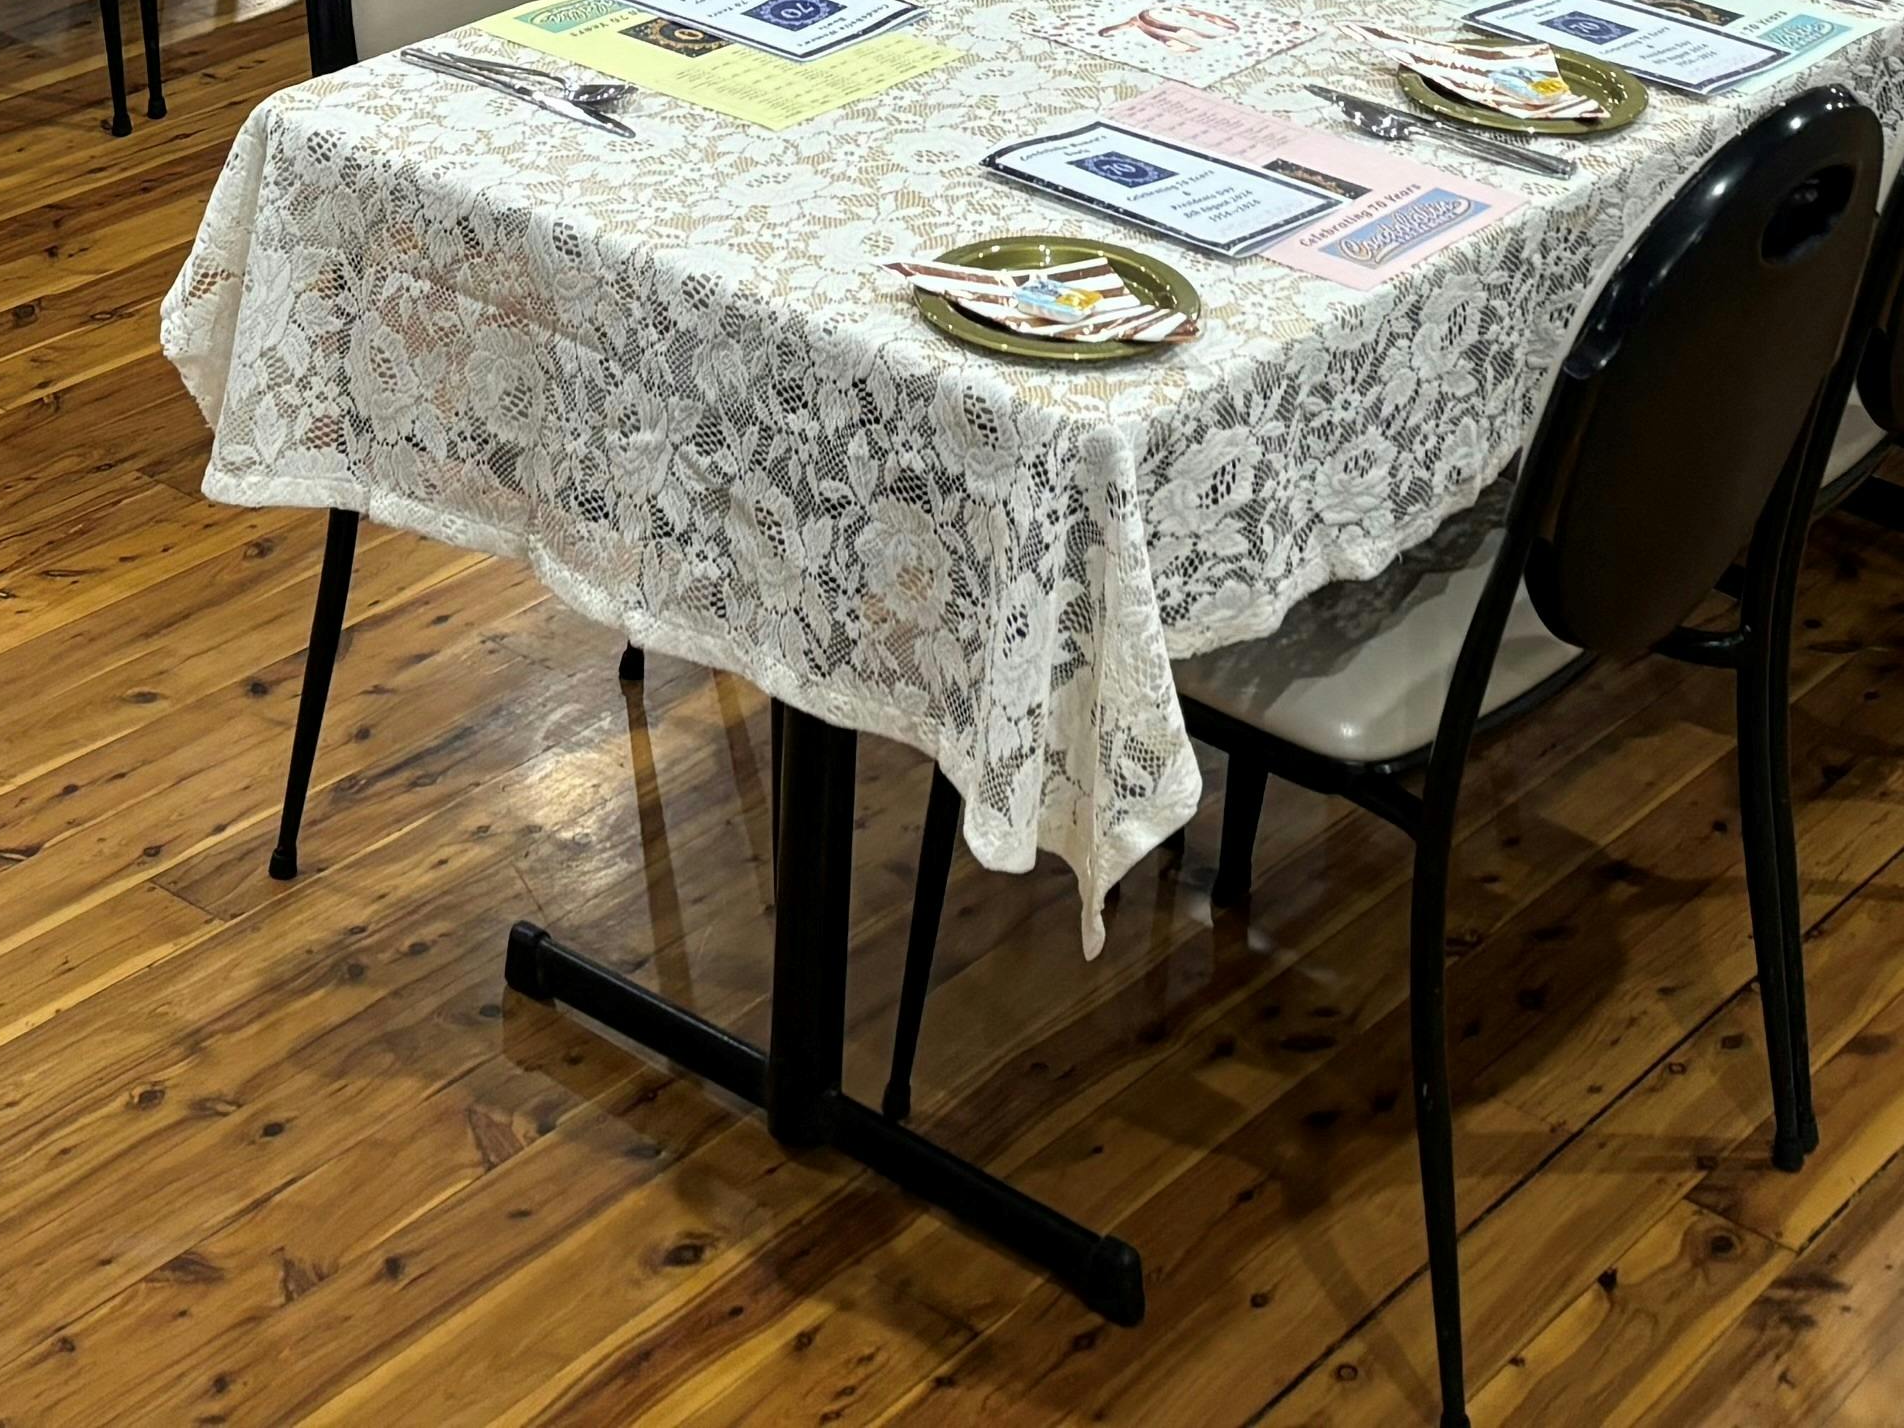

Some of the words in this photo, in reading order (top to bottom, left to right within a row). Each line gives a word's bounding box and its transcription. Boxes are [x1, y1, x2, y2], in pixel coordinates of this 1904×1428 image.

[781, 1, 815, 20] 70
[1758, 10, 1788, 28] Years
[1570, 21, 1600, 36] 70
[1102, 162, 1136, 177] 70
[1191, 169, 1214, 182] Years
[1201, 197, 1230, 215] August
[1300, 209, 1372, 247] Celebrating
[1370, 199, 1385, 213] 70
[1384, 183, 1422, 203] Years
